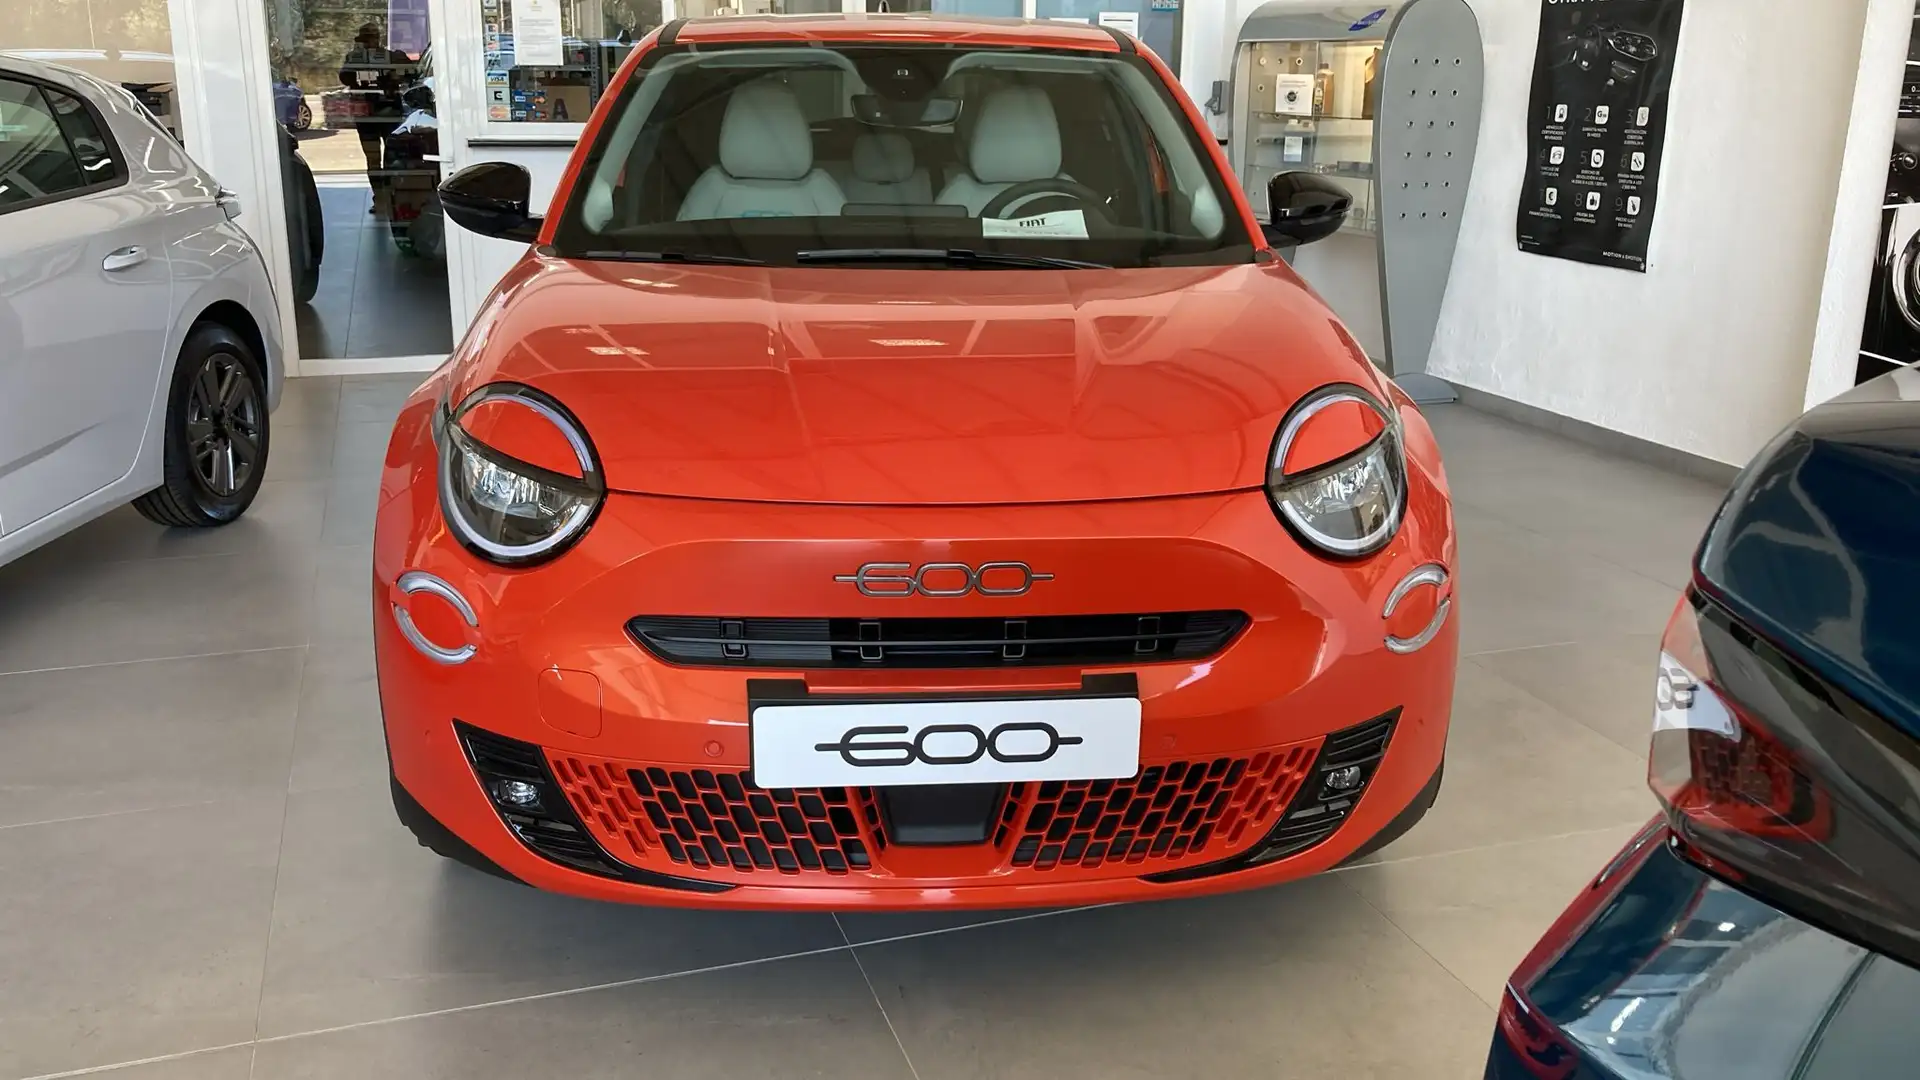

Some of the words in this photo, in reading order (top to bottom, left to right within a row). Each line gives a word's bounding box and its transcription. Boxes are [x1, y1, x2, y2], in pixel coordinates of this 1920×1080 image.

[1019, 217, 1046, 227] FIAT
[1602, 250, 1621, 258] MOTION
[844, 562, 1044, 597] 600
[828, 721, 1071, 767] 600
